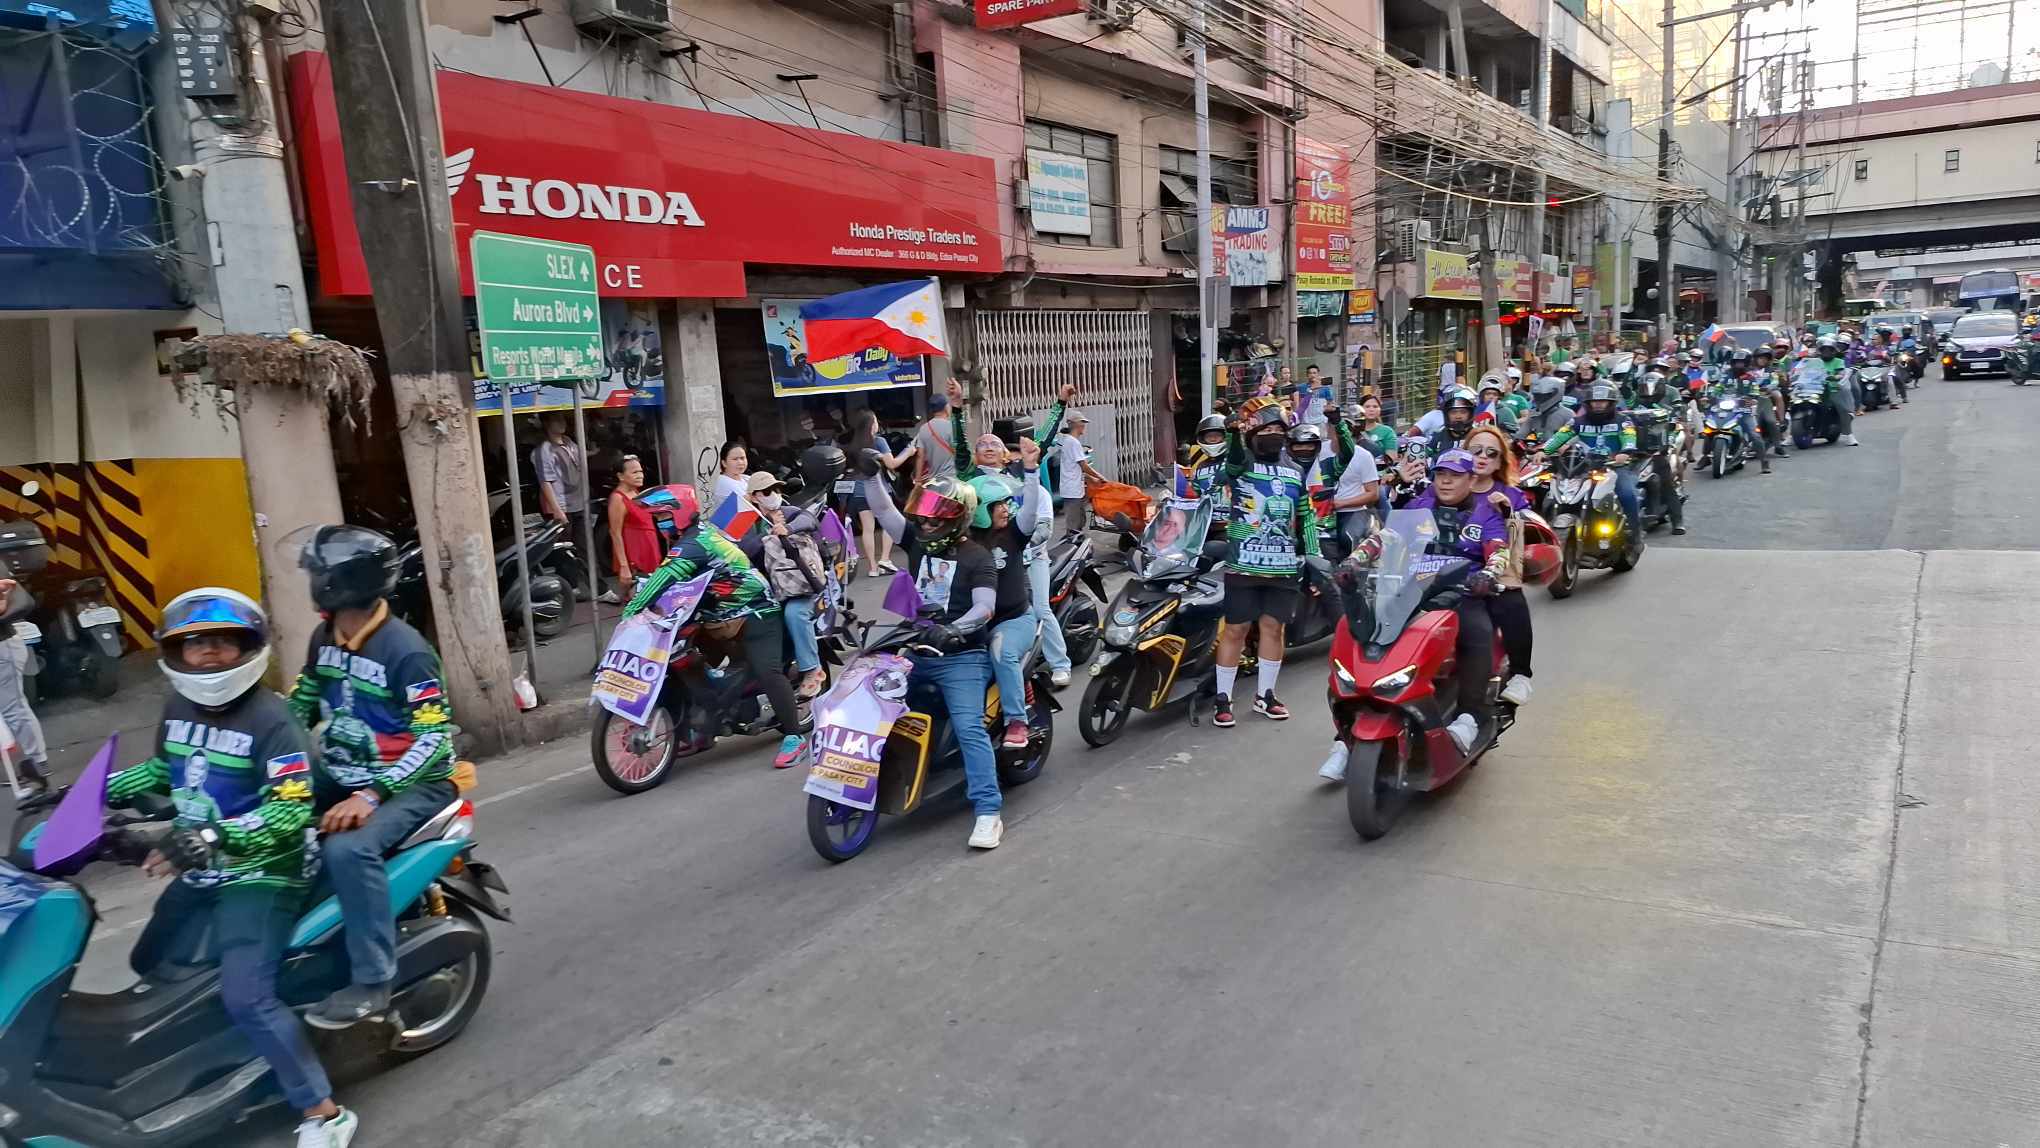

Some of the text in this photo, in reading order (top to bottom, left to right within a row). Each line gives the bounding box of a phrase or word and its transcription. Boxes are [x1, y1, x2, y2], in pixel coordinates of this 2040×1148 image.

[987, 0, 1024, 14] SPARE
[475, 174, 705, 226] HONDA
[1228, 208, 1267, 229] AMMJ
[850, 222, 978, 245] Honda Prestige Traders Inc.
[864, 247, 875, 257] MC
[876, 248, 894, 258] Dealer
[546, 254, 576, 280] SLEX
[513, 298, 580, 323] Aurora Blvd
[493, 347, 528, 364] Resorts
[864, 346, 889, 362] Daily
[1469, 527, 1481, 540] 53
[1246, 544, 1282, 553] STAND
[846, 776, 866, 785] CITY
